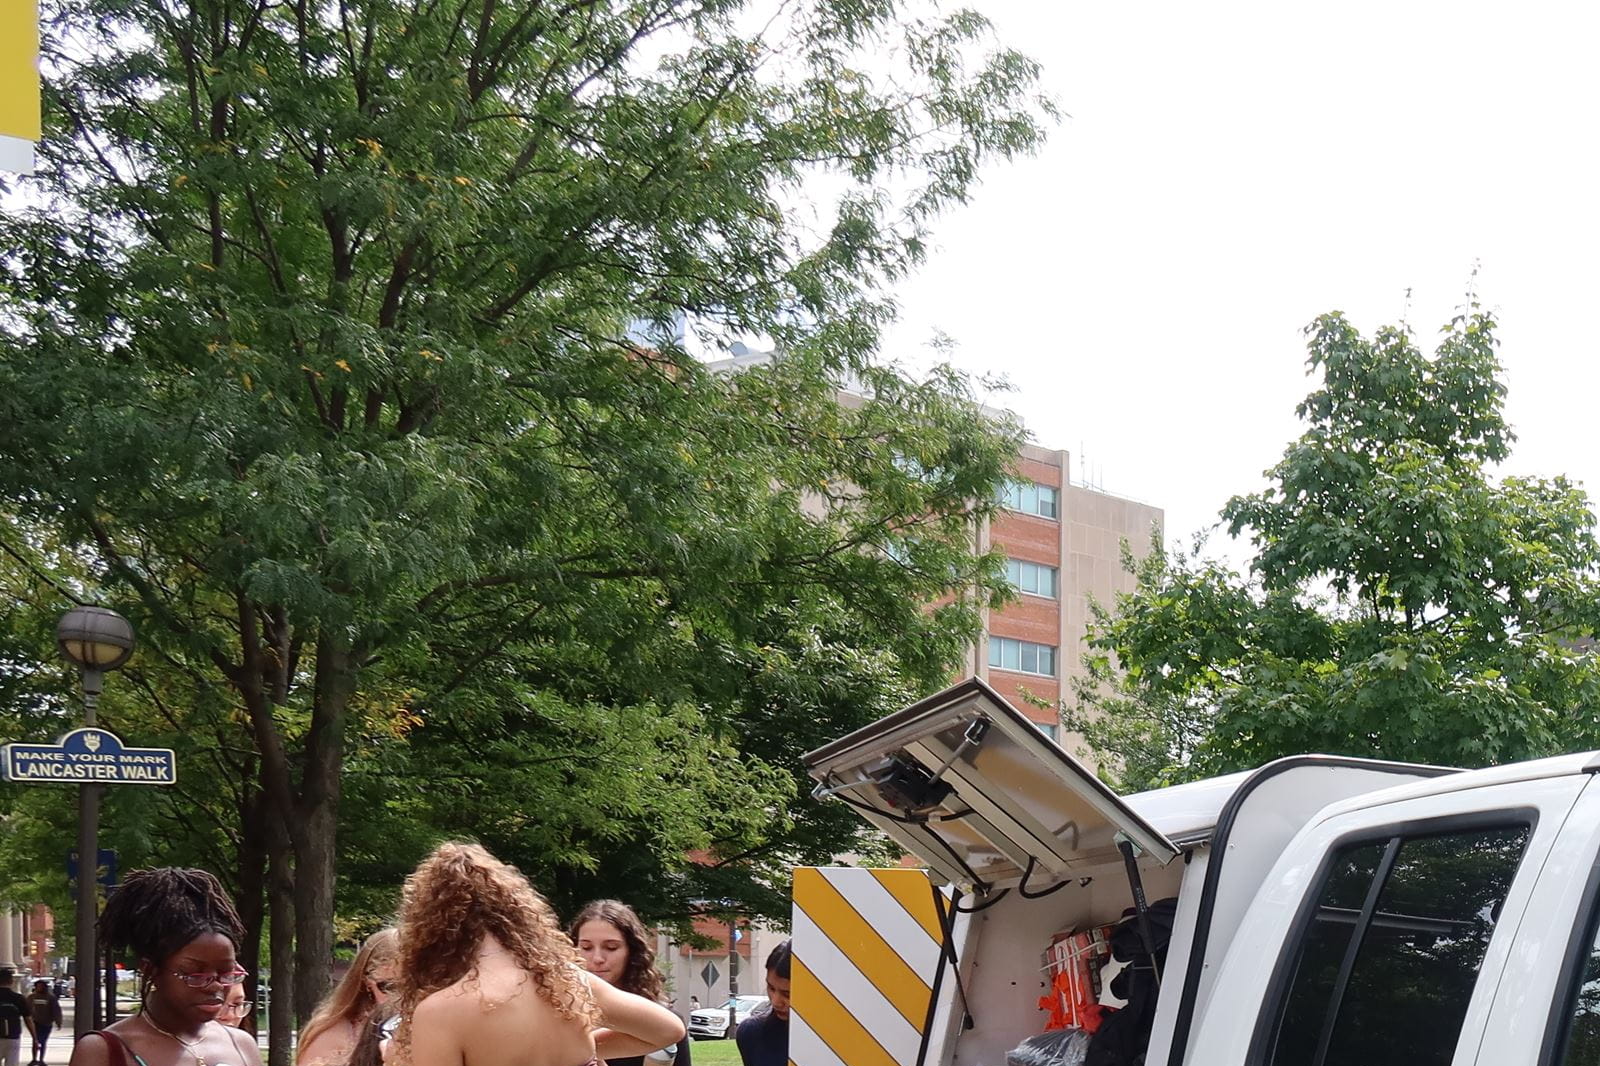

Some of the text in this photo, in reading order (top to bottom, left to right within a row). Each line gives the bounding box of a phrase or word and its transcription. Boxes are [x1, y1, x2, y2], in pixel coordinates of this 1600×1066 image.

[15, 752, 167, 764] MAKE YOUR MARK
[15, 762, 169, 780] LANCASTER WALK
